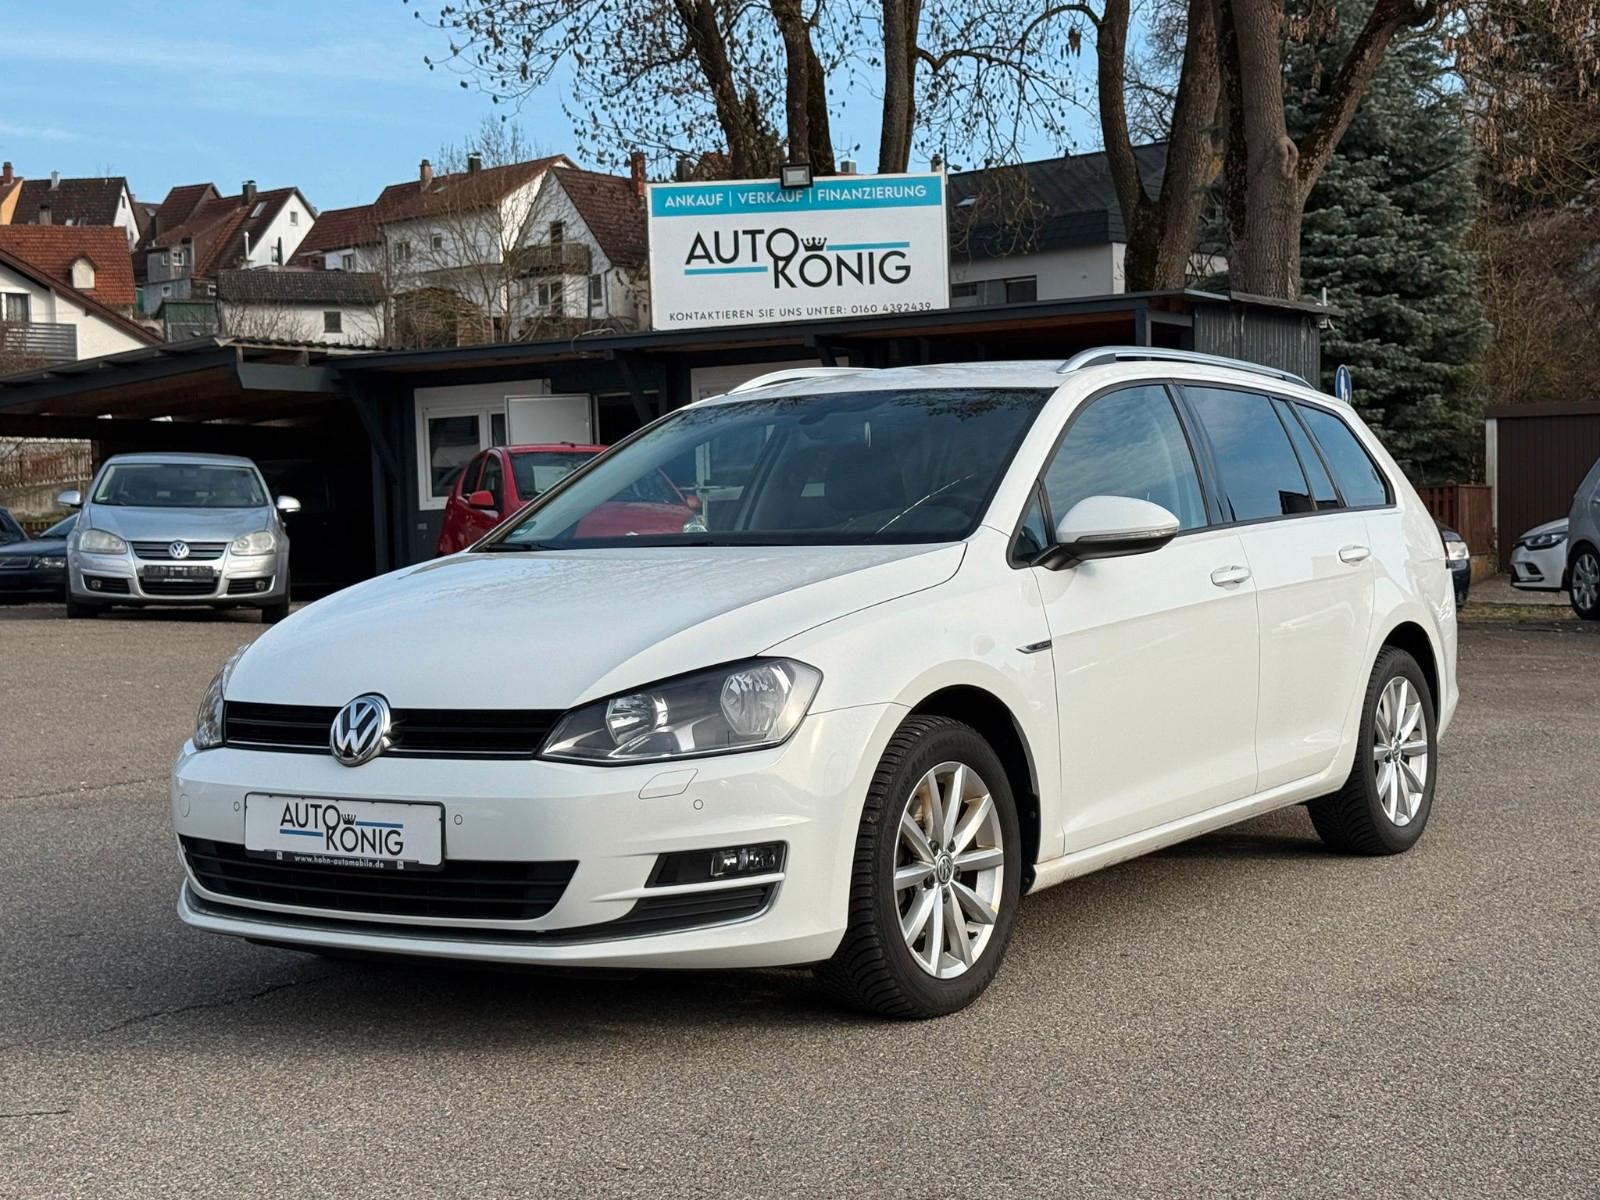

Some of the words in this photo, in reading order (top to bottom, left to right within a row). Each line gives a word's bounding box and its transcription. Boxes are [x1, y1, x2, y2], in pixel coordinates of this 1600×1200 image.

[664, 193, 724, 208] ANKAUF
[737, 189, 804, 205] VERKAUF
[817, 184, 927, 201] FINANZIERUNG
[685, 227, 800, 265] AUTO
[669, 308, 754, 321] KONTAKTIEREN
[758, 308, 775, 318] SIE
[779, 307, 803, 317] UNS
[806, 305, 847, 316] UNTER:
[851, 303, 878, 314] 0160
[331, 694, 386, 763] VW
[280, 801, 341, 829] AUTO
[294, 855, 384, 869] www.hahn-automobile.de
